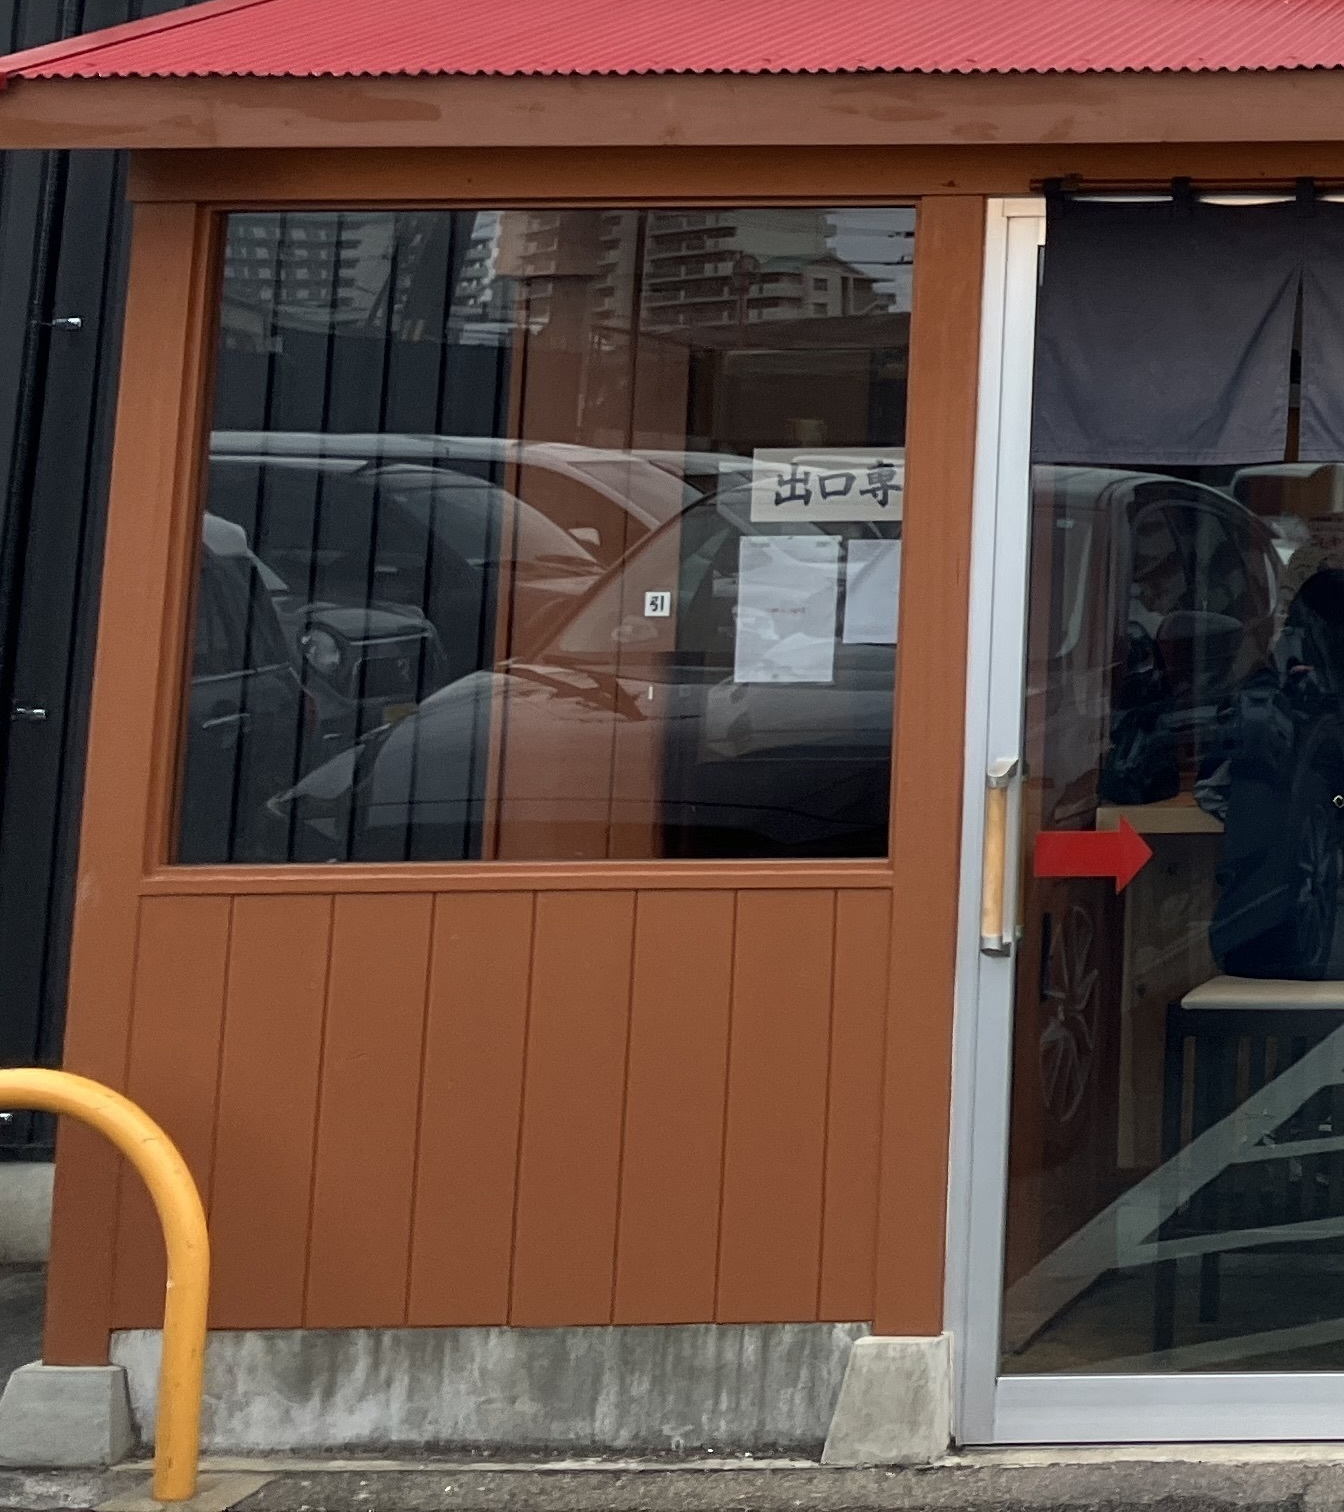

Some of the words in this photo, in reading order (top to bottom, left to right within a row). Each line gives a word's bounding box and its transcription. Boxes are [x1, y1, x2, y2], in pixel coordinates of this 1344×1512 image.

[774, 460, 904, 508] 出口専
[650, 594, 665, 612] 引
